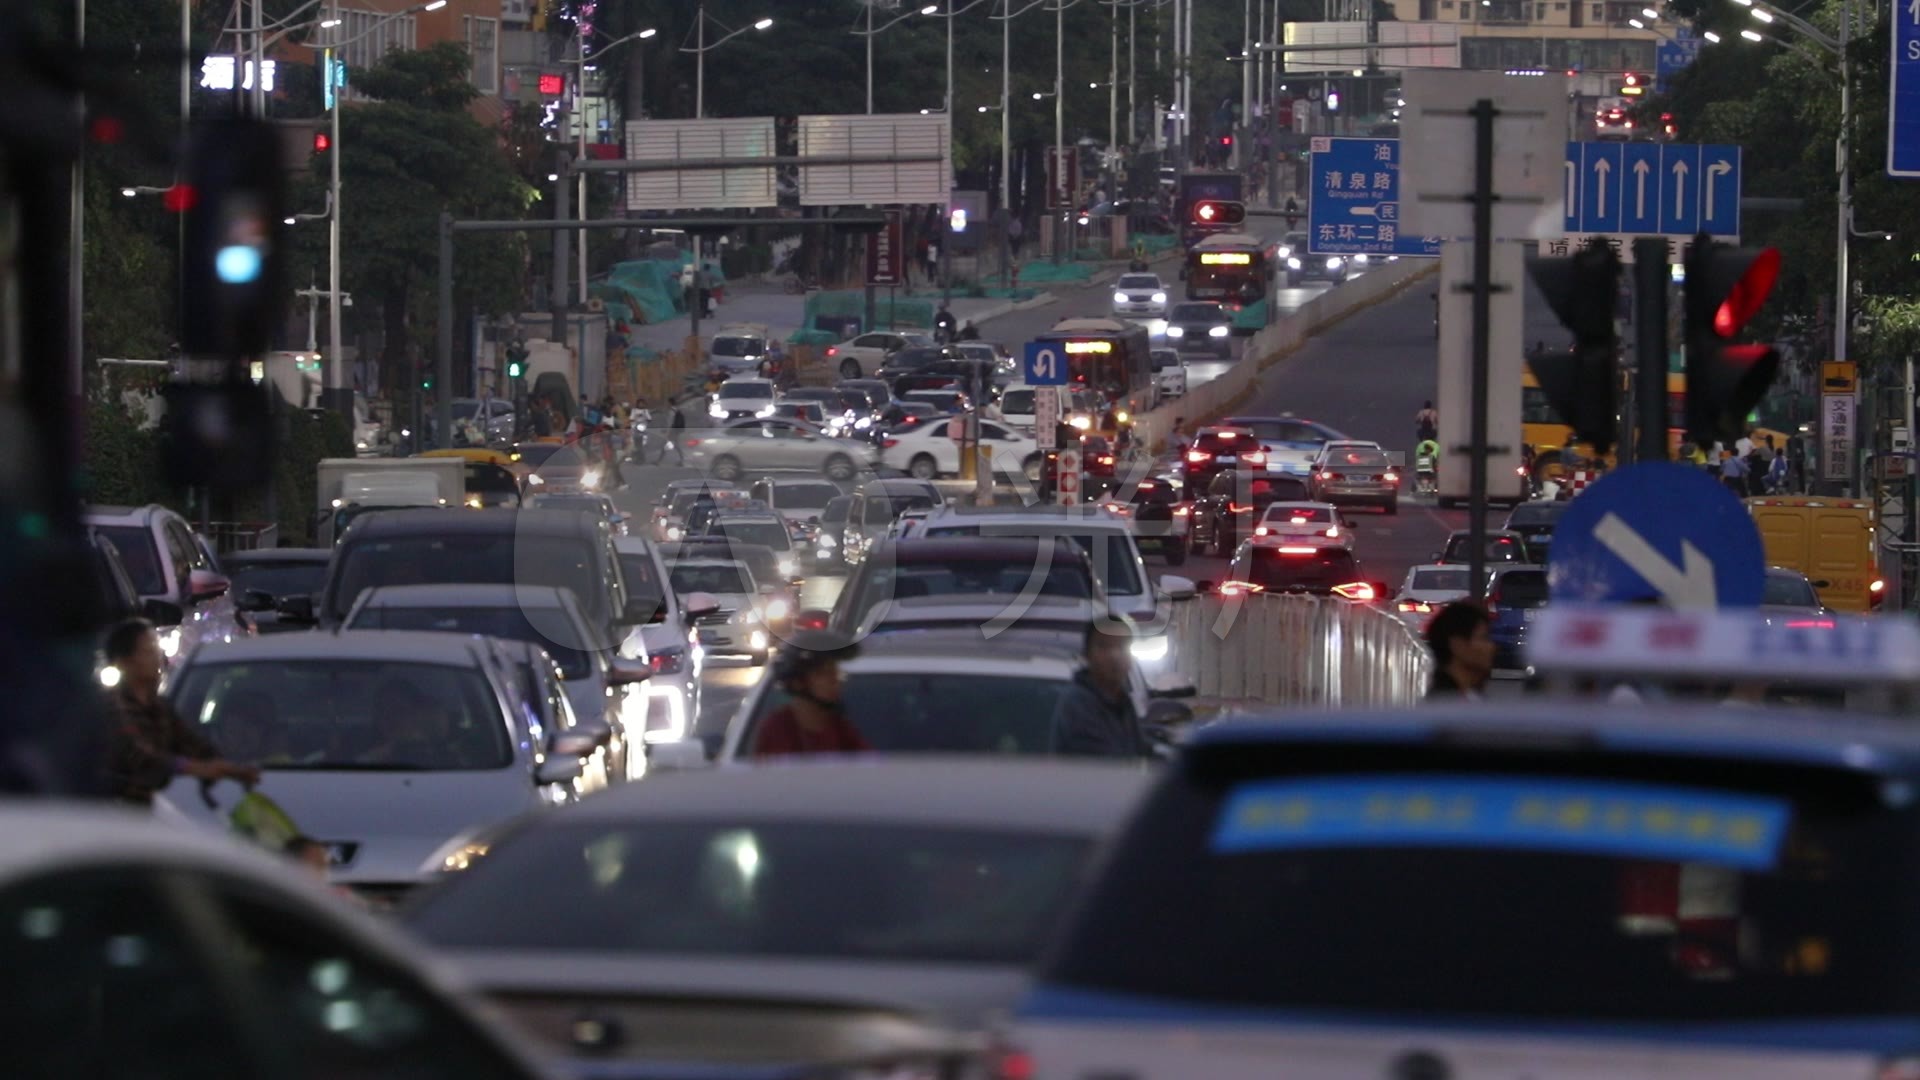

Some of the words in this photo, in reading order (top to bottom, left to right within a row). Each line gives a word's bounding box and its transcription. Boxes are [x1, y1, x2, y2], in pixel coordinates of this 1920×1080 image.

[1325, 171, 1391, 189] 清泉路
[1328, 191, 1369, 199] Qingquan
[1318, 224, 1395, 243] 东环二路
[1318, 243, 1361, 251] Donghuan
[1363, 243, 1380, 251] 2nd
[1382, 243, 1393, 251] Rd
[1831, 399, 1847, 476] 交通繁忙路段
